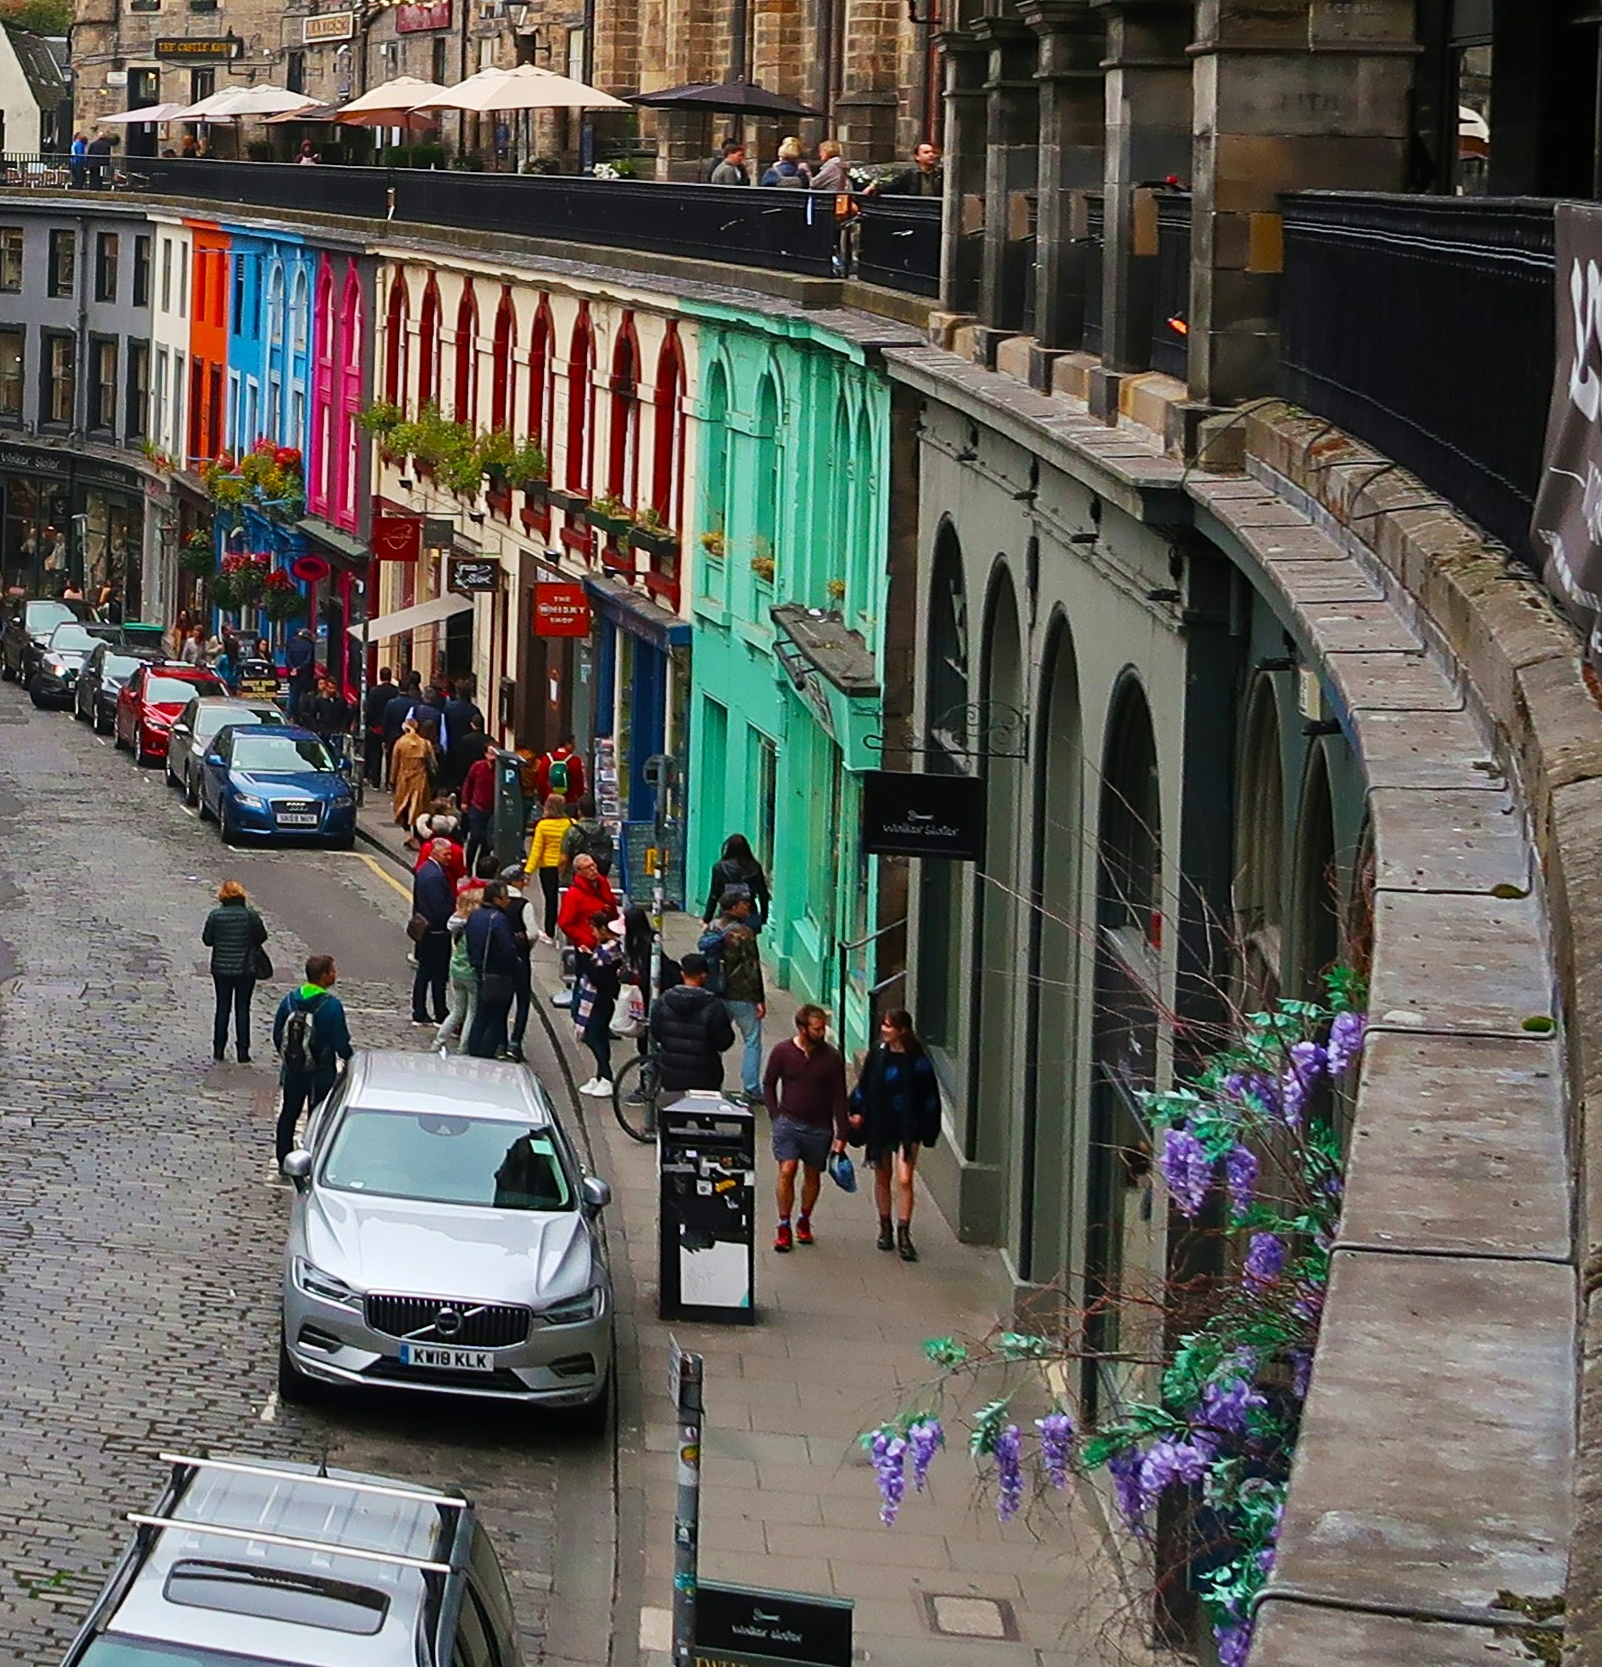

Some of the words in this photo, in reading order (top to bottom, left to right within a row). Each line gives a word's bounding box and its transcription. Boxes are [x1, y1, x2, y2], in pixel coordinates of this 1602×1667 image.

[553, 595, 572, 603] THE
[539, 604, 585, 616] WHISKY
[505, 768, 515, 782] P
[455, 1352, 487, 1369] KLK
